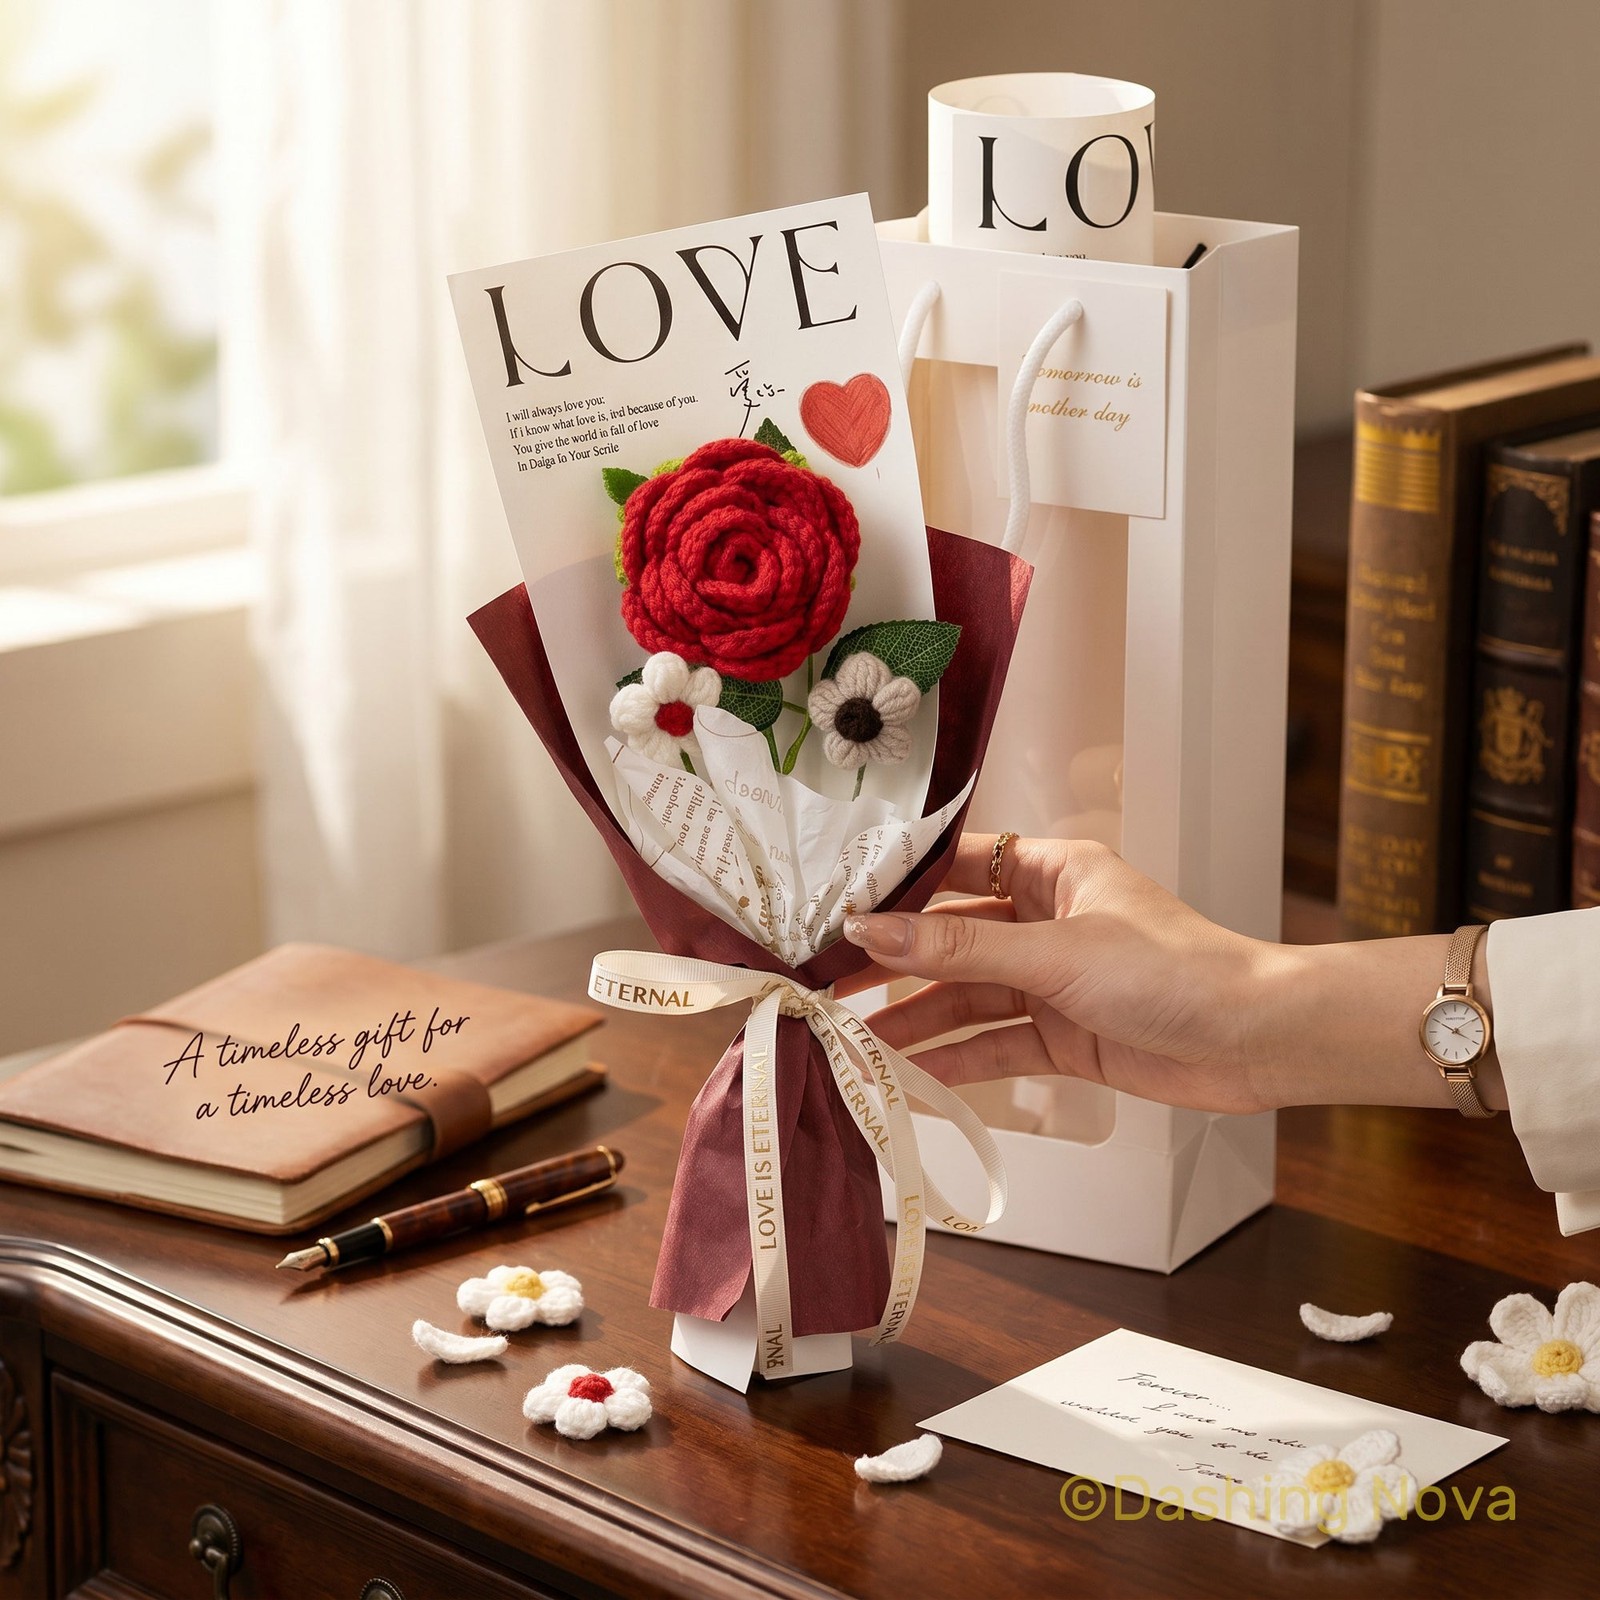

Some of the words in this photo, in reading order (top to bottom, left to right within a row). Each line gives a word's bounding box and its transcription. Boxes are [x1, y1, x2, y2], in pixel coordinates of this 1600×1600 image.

[978, 122, 1155, 231] LO
[483, 219, 858, 388] LOVE
[1127, 372, 1142, 388] is
[506, 412, 511, 423] I
[512, 409, 530, 421] will
[531, 404, 562, 417] always
[563, 400, 584, 412] love
[510, 427, 518, 439] If
[525, 424, 550, 436] know
[552, 418, 575, 430] what
[576, 414, 596, 426] love
[597, 411, 609, 422] is,
[627, 400, 664, 416] because
[665, 395, 677, 408] of
[677, 395, 699, 409] you.
[513, 444, 533, 455] You
[534, 439, 554, 454] give
[555, 436, 570, 448] the
[571, 428, 598, 443] world
[610, 423, 626, 437] fall
[627, 420, 638, 433] of
[638, 419, 659, 431] love
[1028, 397, 1088, 418] nother
[1093, 401, 1131, 432] day
[517, 461, 528, 472] In
[568, 449, 591, 461] Your
[593, 975, 695, 1008] ETERNAL
[163, 1031, 205, 1085] A
[216, 1023, 345, 1067] timeless
[348, 1010, 416, 1070] gift
[422, 1006, 470, 1053] for
[841, 1016, 900, 1111] ETERNAL
[196, 1100, 219, 1120] a
[227, 1072, 357, 1117] timeless
[367, 1063, 438, 1098] love.
[751, 1044, 771, 1154] ETERNAL
[832, 1053, 890, 1153] ETERNAL
[754, 1159, 772, 1181] IS
[755, 1187, 777, 1250] LOVE
[903, 1194, 920, 1248] LOVE
